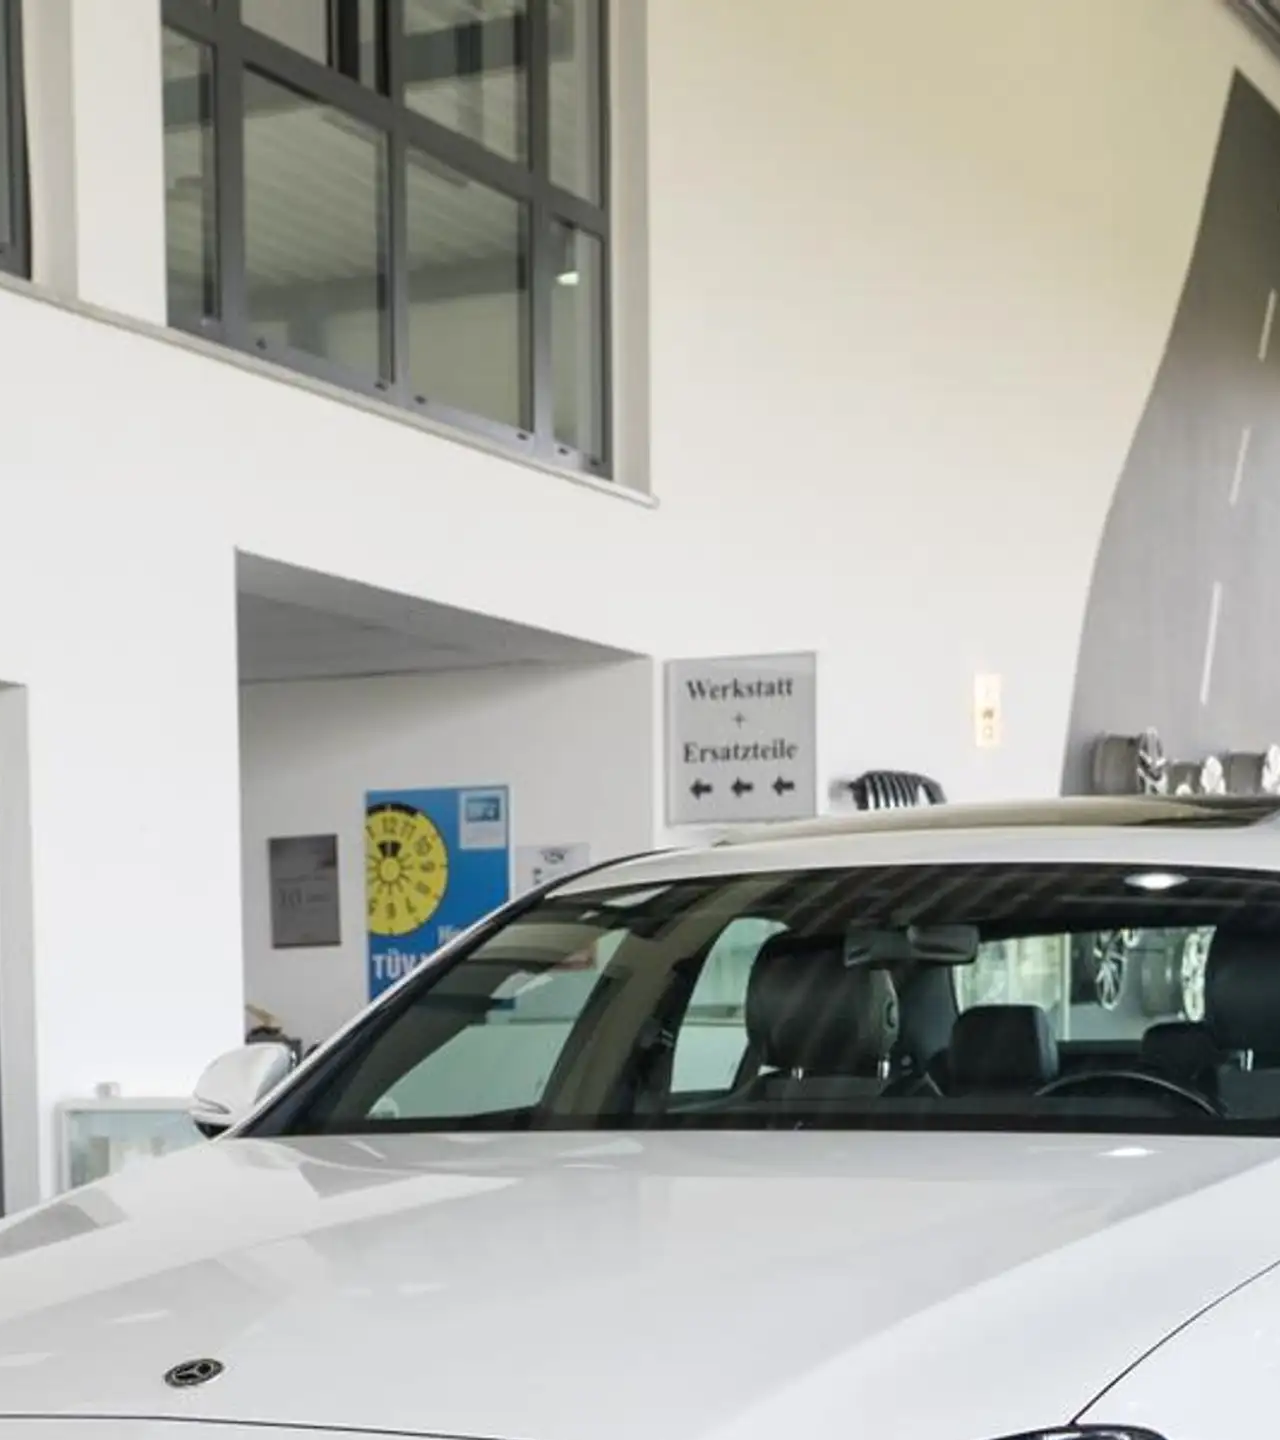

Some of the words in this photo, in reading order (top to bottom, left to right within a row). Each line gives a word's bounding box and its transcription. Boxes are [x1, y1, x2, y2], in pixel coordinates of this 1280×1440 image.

[685, 677, 793, 701] Werkstatt
[683, 738, 799, 763] Ersatzteile
[372, 947, 417, 981] TÜV
